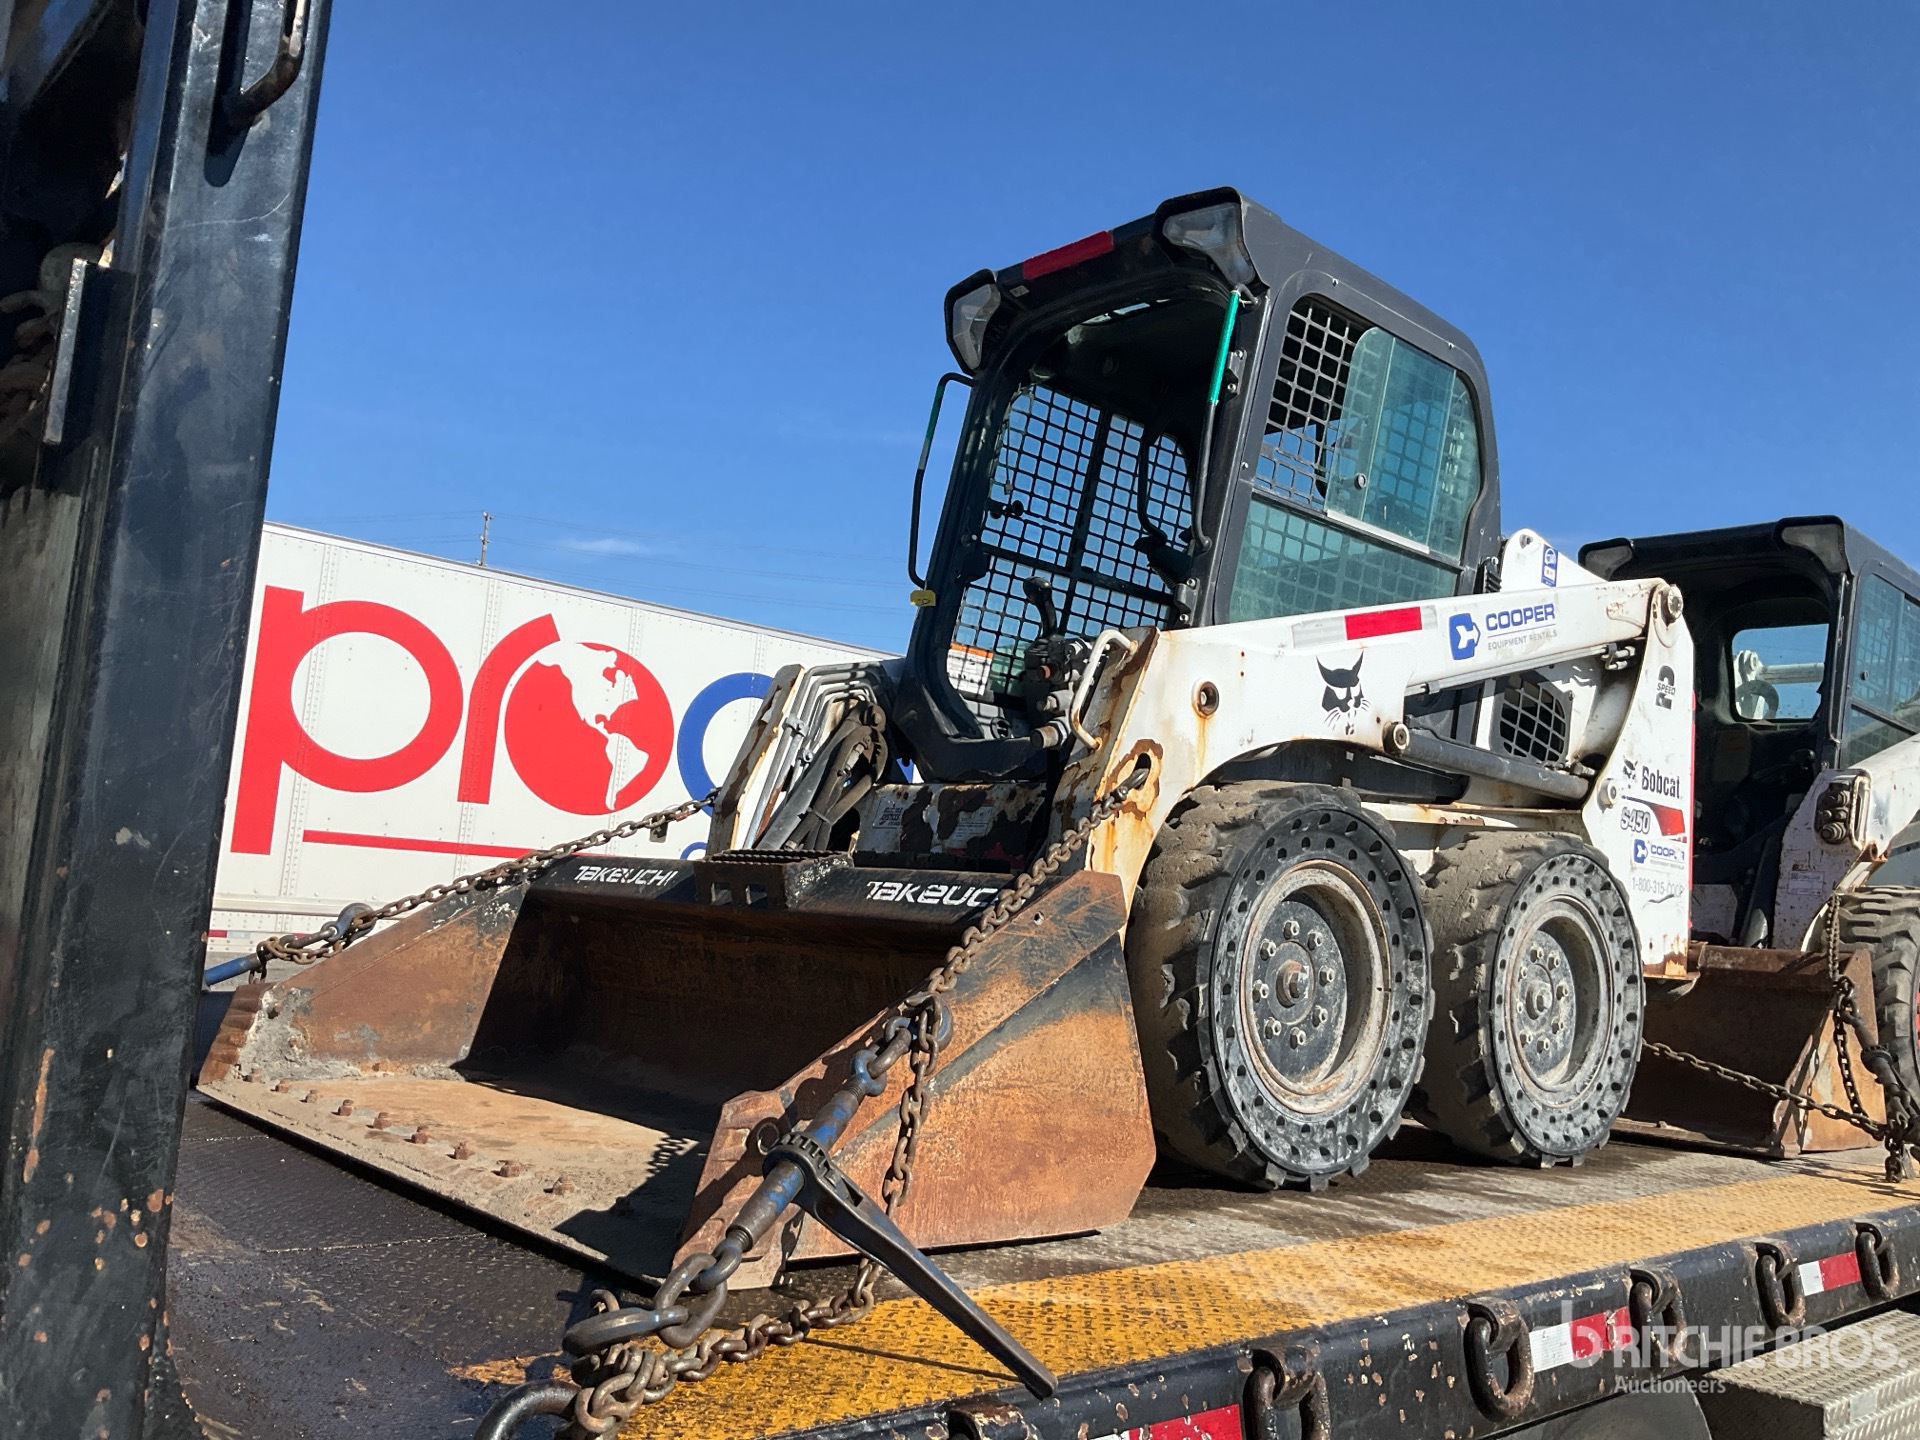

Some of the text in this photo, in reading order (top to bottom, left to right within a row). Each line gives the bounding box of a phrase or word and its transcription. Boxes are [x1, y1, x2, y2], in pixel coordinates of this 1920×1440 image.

[1486, 603, 1556, 631] COOPER
[1488, 630, 1558, 651] EQUIPMENT RENTALS
[1657, 682, 1676, 695] SPEED
[1642, 765, 1680, 799] Bobcat
[1620, 806, 1651, 834] S450
